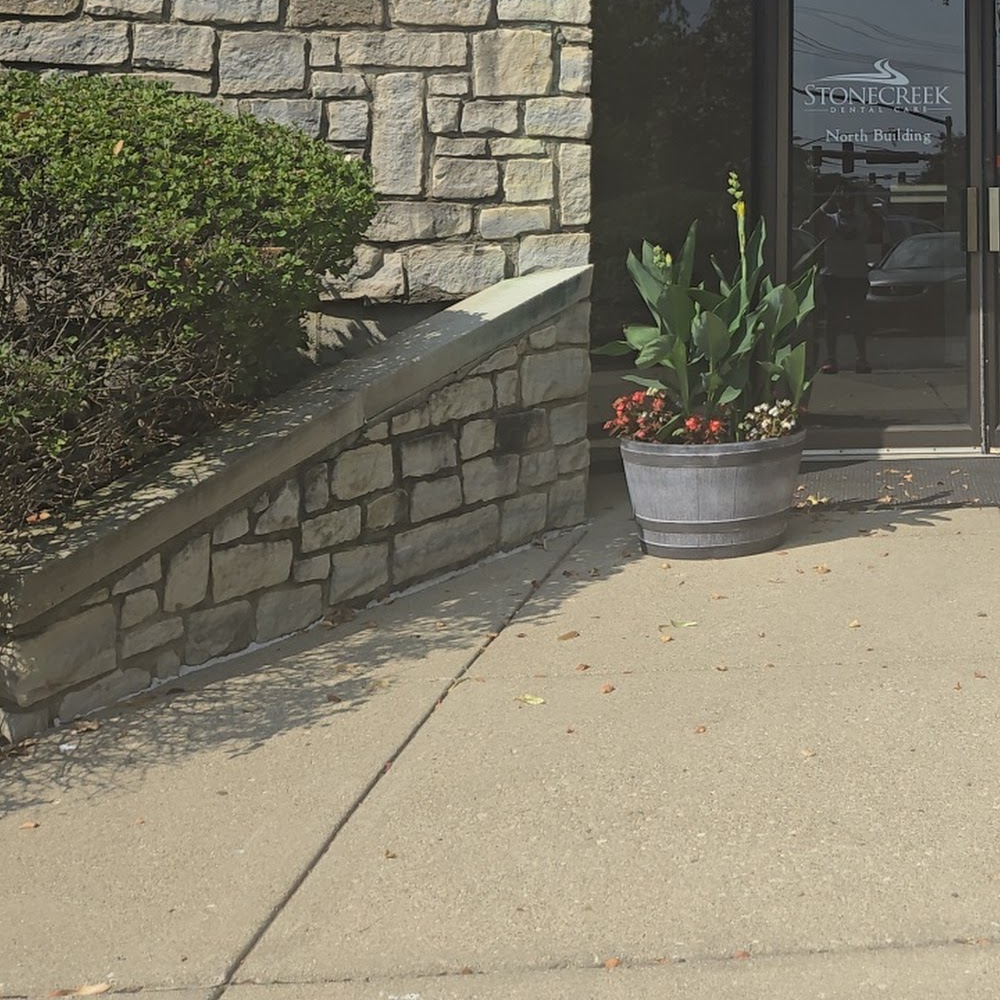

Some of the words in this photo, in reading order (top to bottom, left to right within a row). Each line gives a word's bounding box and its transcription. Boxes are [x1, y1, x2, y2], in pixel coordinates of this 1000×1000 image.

[804, 84, 951, 105] STONECREEK
[826, 128, 868, 142] North
[874, 128, 931, 145] Building
